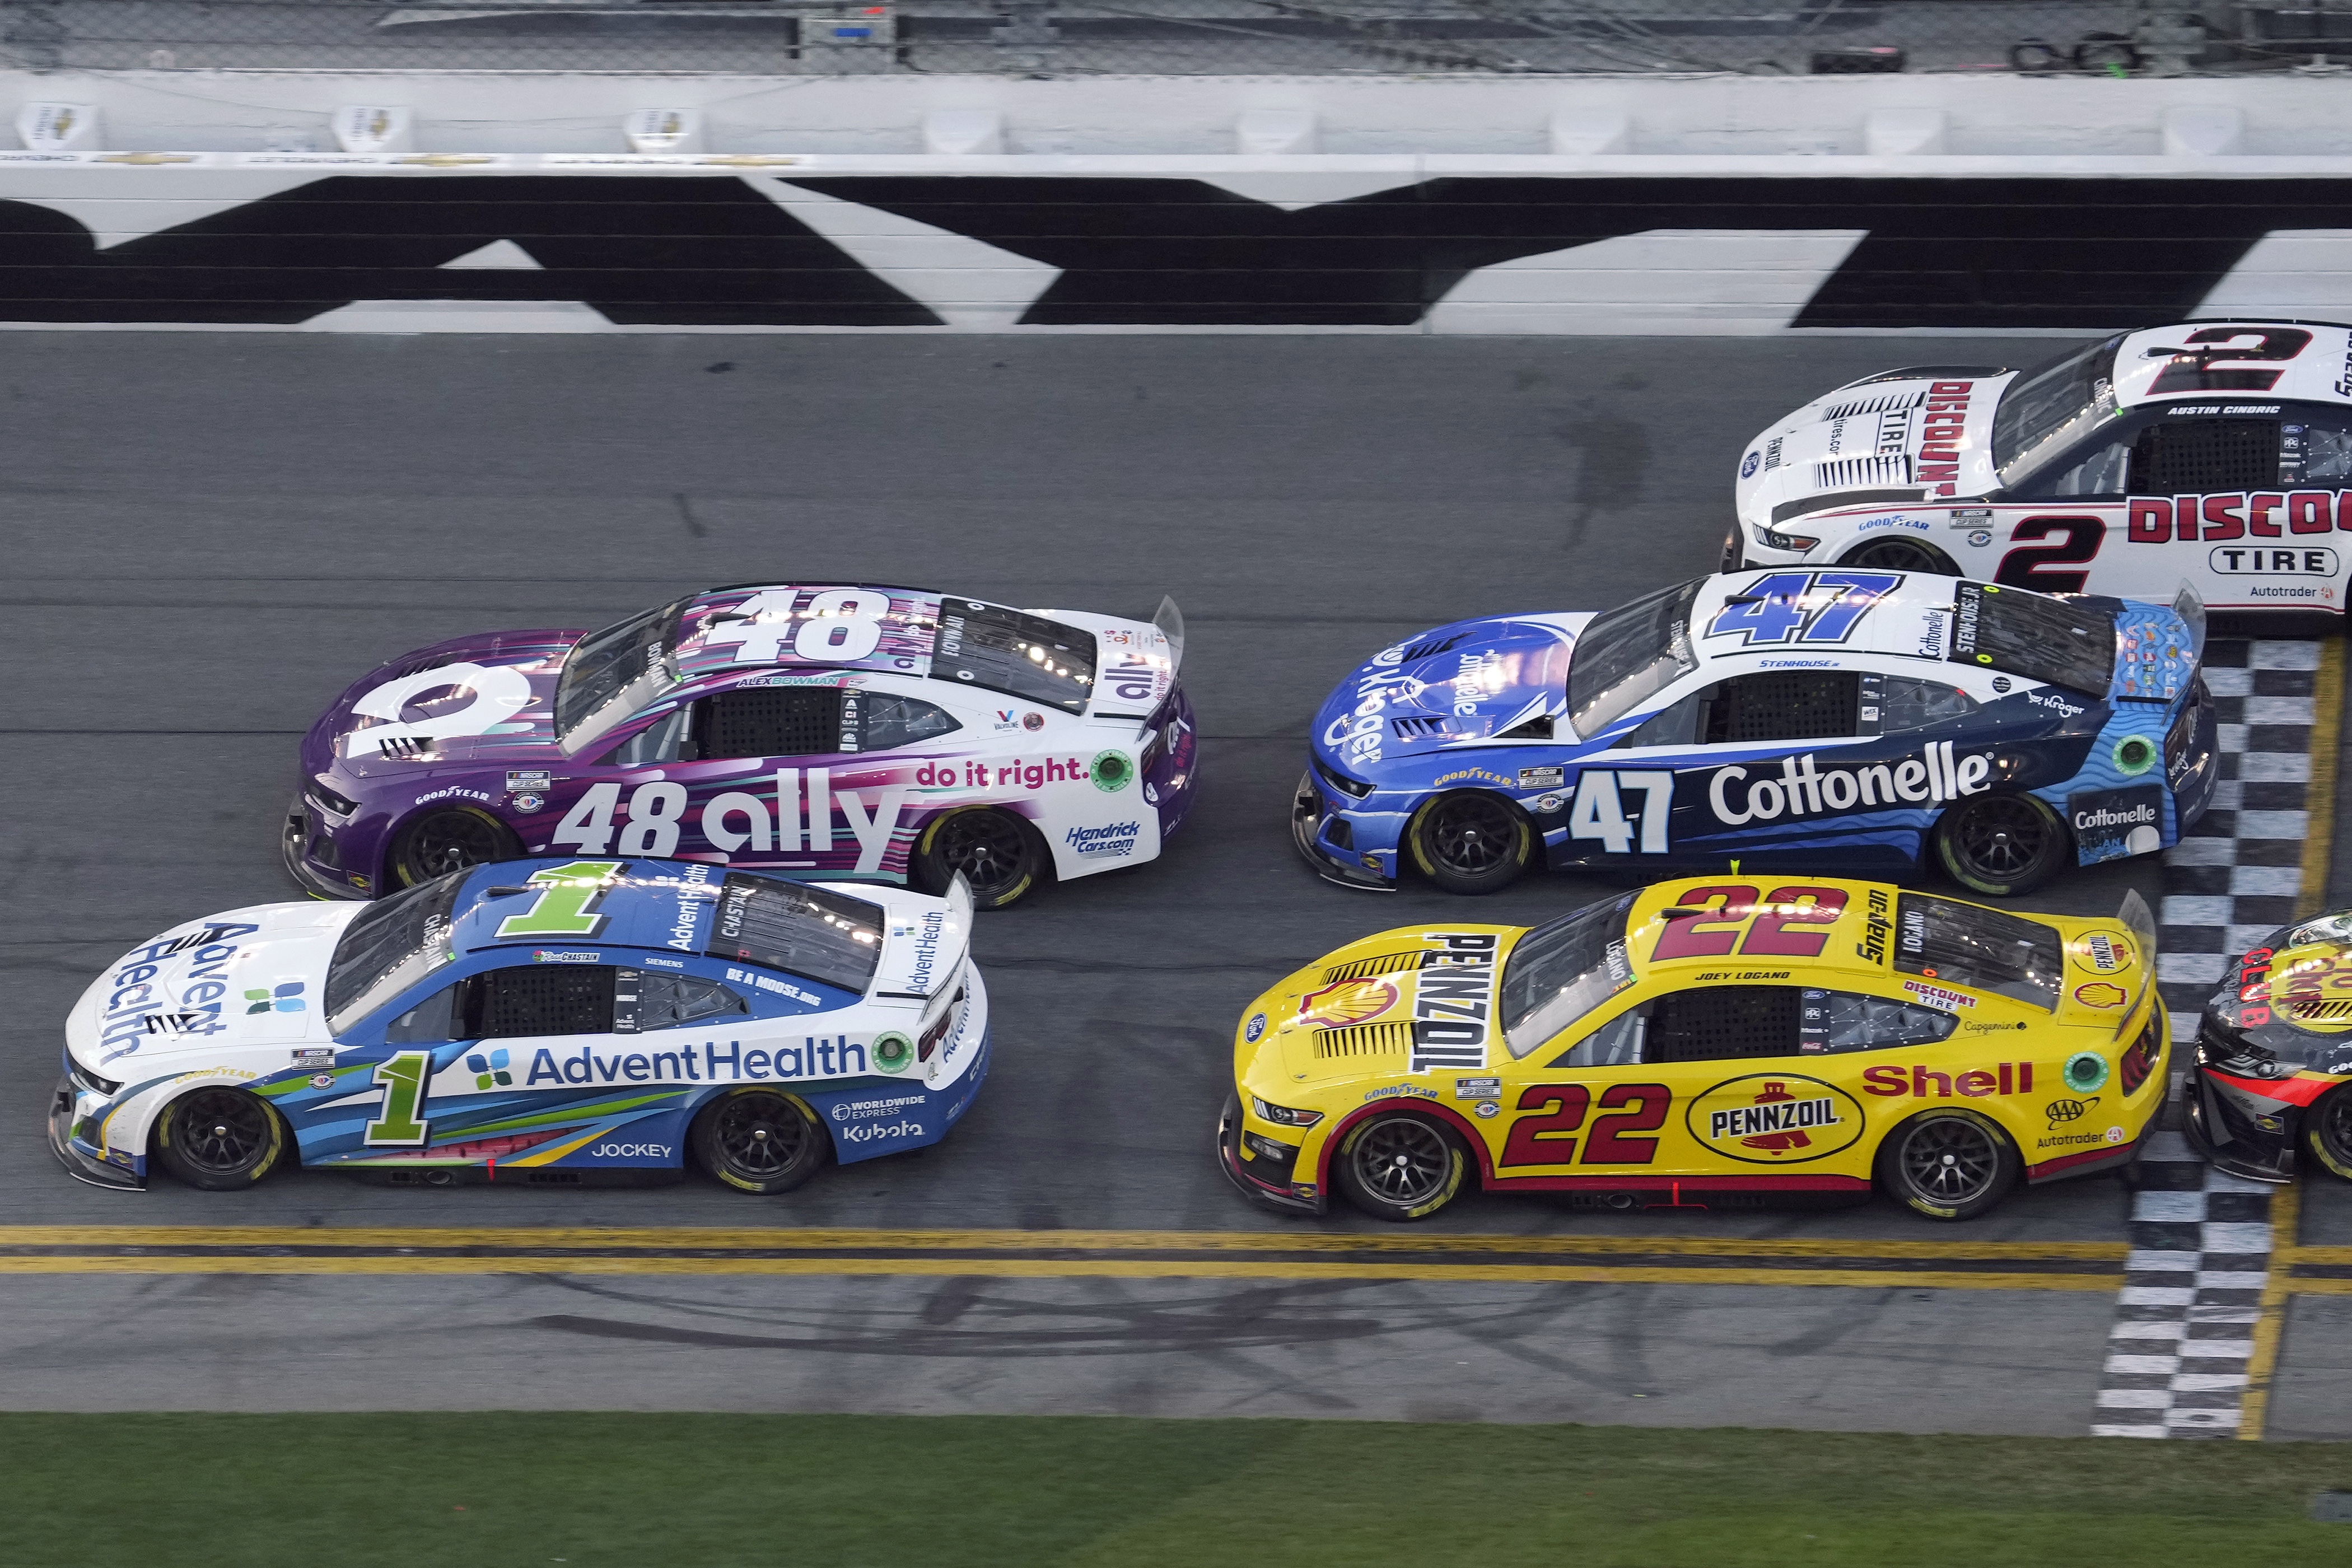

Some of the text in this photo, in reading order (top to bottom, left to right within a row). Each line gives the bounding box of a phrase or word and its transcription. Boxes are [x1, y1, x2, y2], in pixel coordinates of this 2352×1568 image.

[2146, 327, 2313, 395] 2
[2168, 405, 2280, 415] AUSTIN CINDRIC
[1881, 410, 1907, 454] TIRE
[1916, 381, 1975, 496] DISCOUNT
[1743, 452, 1760, 478] Ford
[1765, 436, 1783, 472] PENNZOIL
[1859, 515, 1930, 531] GOODYEAR
[1992, 515, 2107, 592] 2
[2223, 550, 2325, 572] TIRE
[2251, 586, 2316, 598] Autotrader
[1703, 572, 1906, 646] 47
[704, 589, 891, 662] 48
[1919, 611, 1945, 657] Cottonelle
[2044, 695, 2084, 718] Kroger
[917, 762, 955, 787] do
[966, 761, 987, 786] it
[998, 758, 1089, 789] right.
[1434, 767, 1511, 786] GOODYEAR
[1709, 741, 1991, 825] Cottonelle
[415, 786, 490, 805] GOODYEAR
[552, 781, 687, 857] 48
[702, 768, 908, 874] ally
[1569, 768, 1676, 855] 47
[2075, 804, 2155, 829] Cottonelle
[1066, 821, 1139, 842] Hendrick
[1078, 839, 1133, 853] Cars.com
[493, 861, 624, 939] 1
[1650, 885, 1850, 962] 22
[1857, 889, 1893, 965] Snap-on
[562, 952, 598, 961] CHASTAIN
[645, 958, 683, 968] SIEMENS
[2089, 934, 2117, 970] PENNZOIL
[179, 922, 259, 1035] Advent
[726, 968, 743, 980] BE
[743, 973, 754, 984] A
[1695, 971, 1791, 982] JOEY LOGANO
[2240, 947, 2272, 1028] CLUB
[99, 939, 178, 1066] Health
[1408, 932, 1501, 1076] PENNZOIL
[1903, 981, 1977, 1007] DISCOUNT
[1922, 997, 1953, 1010] TIRE
[1247, 1015, 1265, 1040] Ford
[1964, 1021, 2016, 1035] Capgemini
[526, 1035, 866, 1085] AdventHealth
[175, 1066, 257, 1084] GOODYEAR
[1863, 1062, 2032, 1097] Shell
[363, 1050, 431, 1146] 1
[851, 1095, 926, 1110] WORLDWIDE
[1365, 1082, 1439, 1102] GOODYEAR
[852, 1107, 901, 1119] EXPRESS
[1710, 1098, 1840, 1140] PENNZOIL
[2048, 1100, 2083, 1120] AAA
[843, 1120, 924, 1142] Kubota
[1499, 1083, 1672, 1168] 22
[592, 1144, 672, 1159] JOCKEY
[2037, 1132, 2104, 1150] Autotrader
